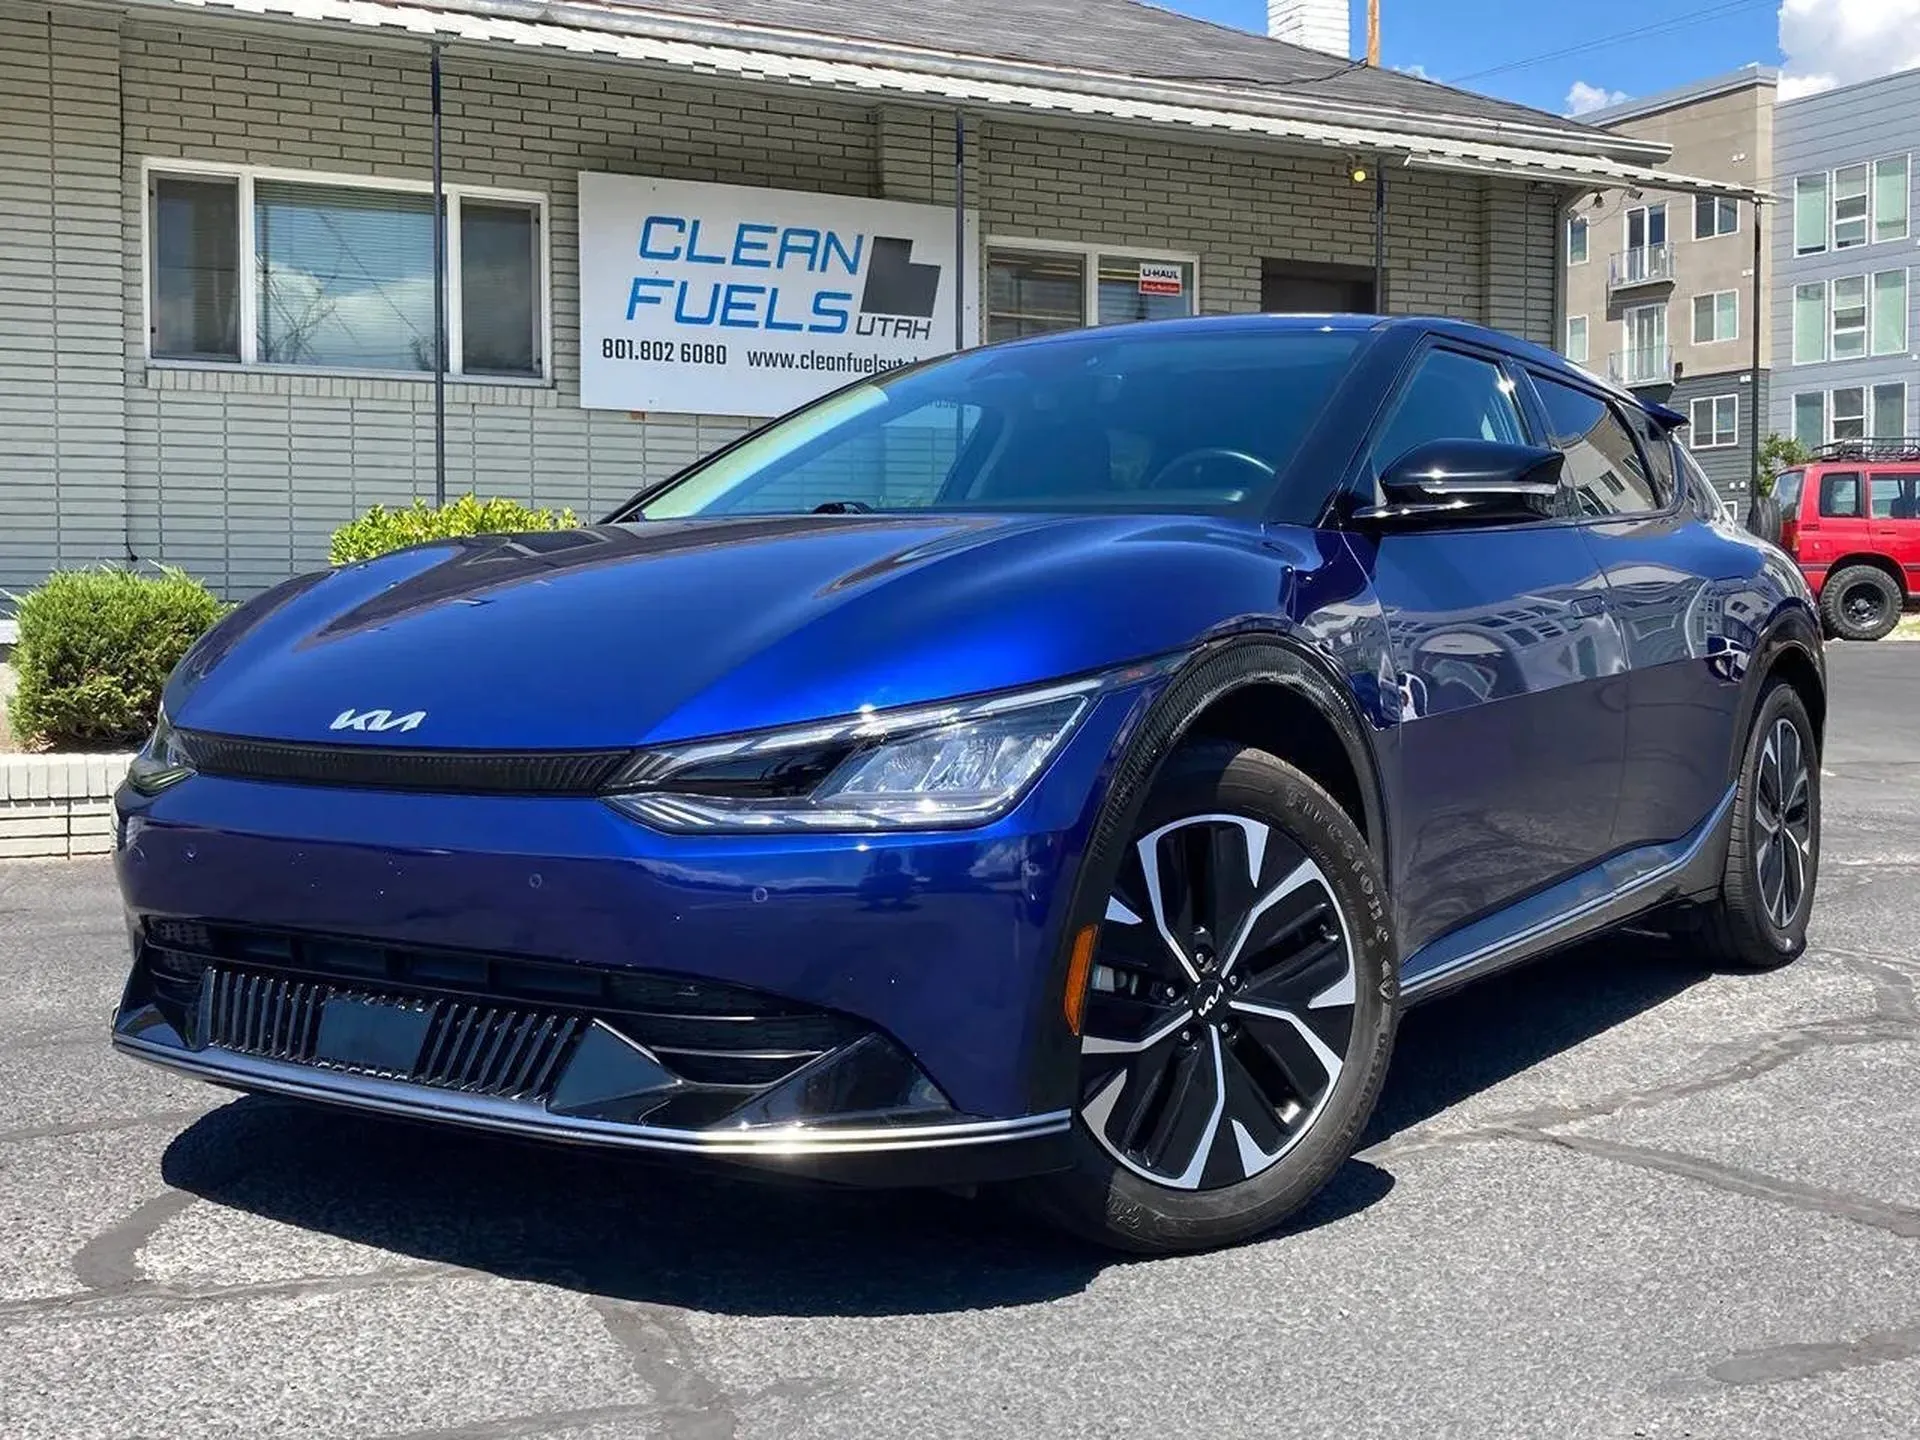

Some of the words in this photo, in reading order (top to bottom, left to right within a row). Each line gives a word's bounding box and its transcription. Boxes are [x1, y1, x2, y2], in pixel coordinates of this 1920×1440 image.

[639, 215, 864, 275] CLEAN
[1142, 269, 1178, 279] U-HAUL
[625, 277, 852, 334] FUELS
[856, 315, 931, 340] UTAH
[602, 338, 674, 362] 801.802
[680, 343, 727, 365] 6080
